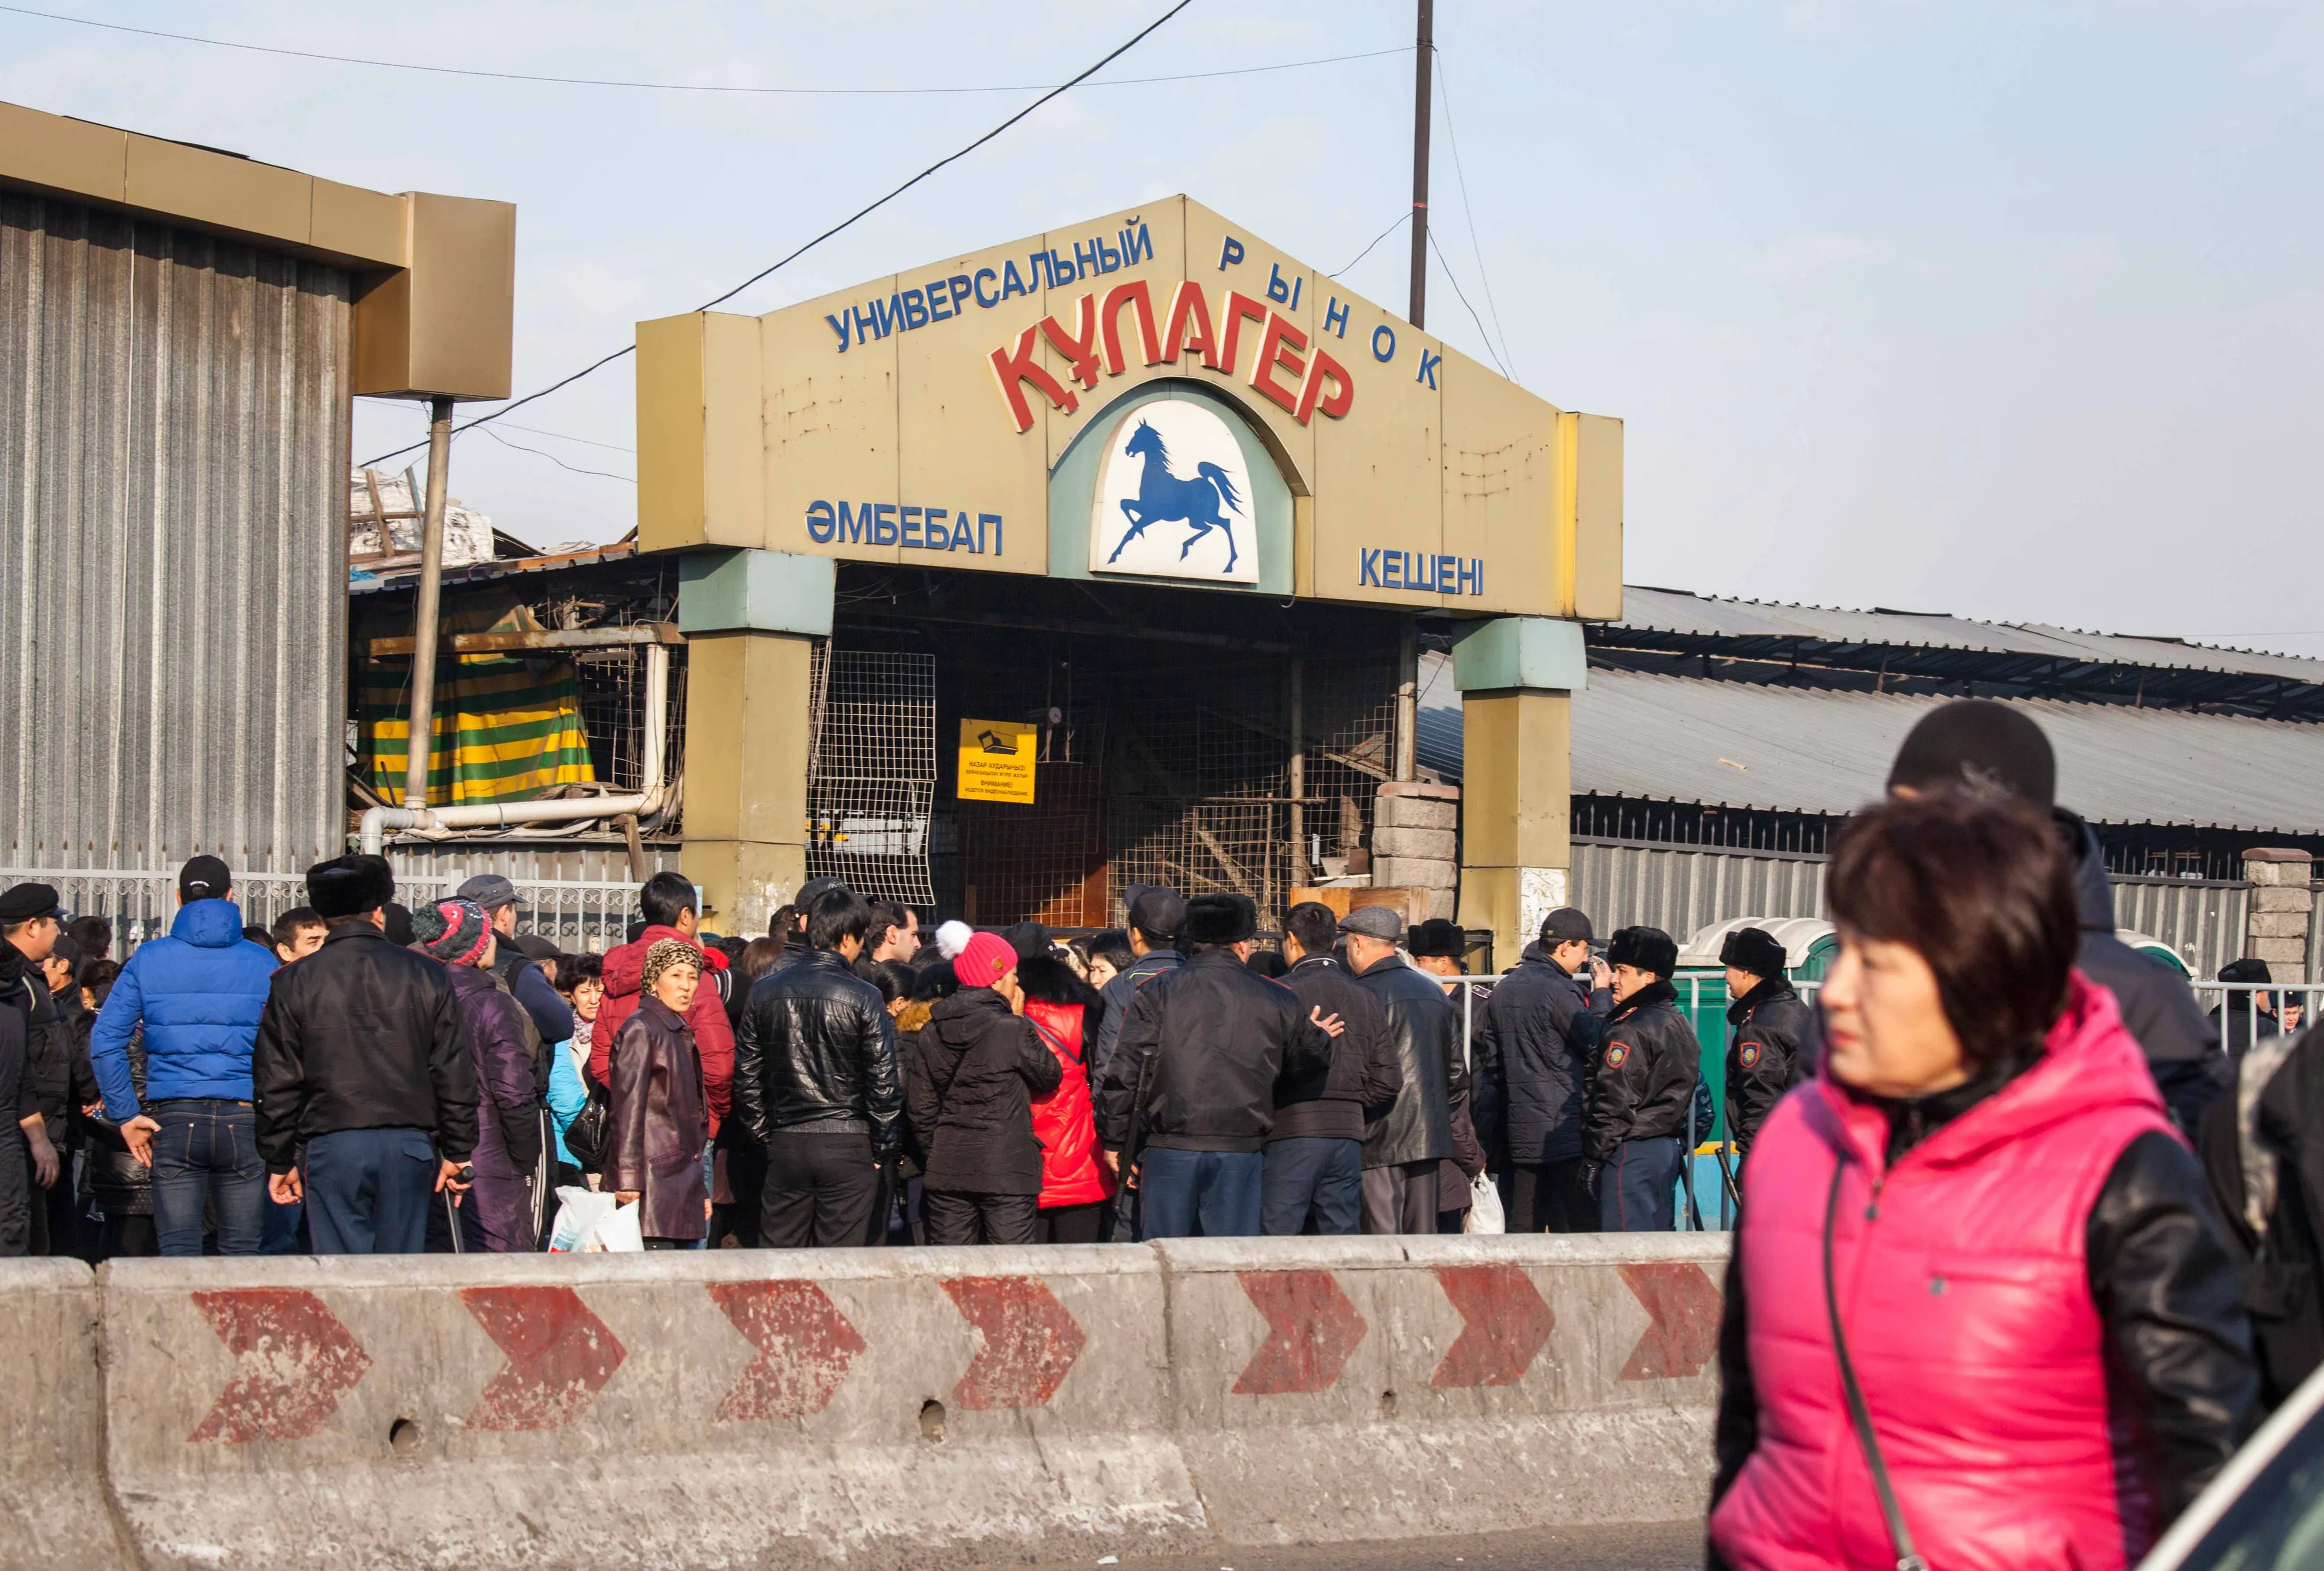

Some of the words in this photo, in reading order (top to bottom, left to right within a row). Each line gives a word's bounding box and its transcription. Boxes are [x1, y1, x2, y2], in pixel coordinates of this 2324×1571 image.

[826, 216, 1154, 352] УНИВЕРСАЛЬНЫЙ
[1218, 236, 1442, 390] РЫНОК
[806, 500, 1002, 556] ӘМБЕБАП
[1359, 547, 1483, 595] КЕШЕНІ
